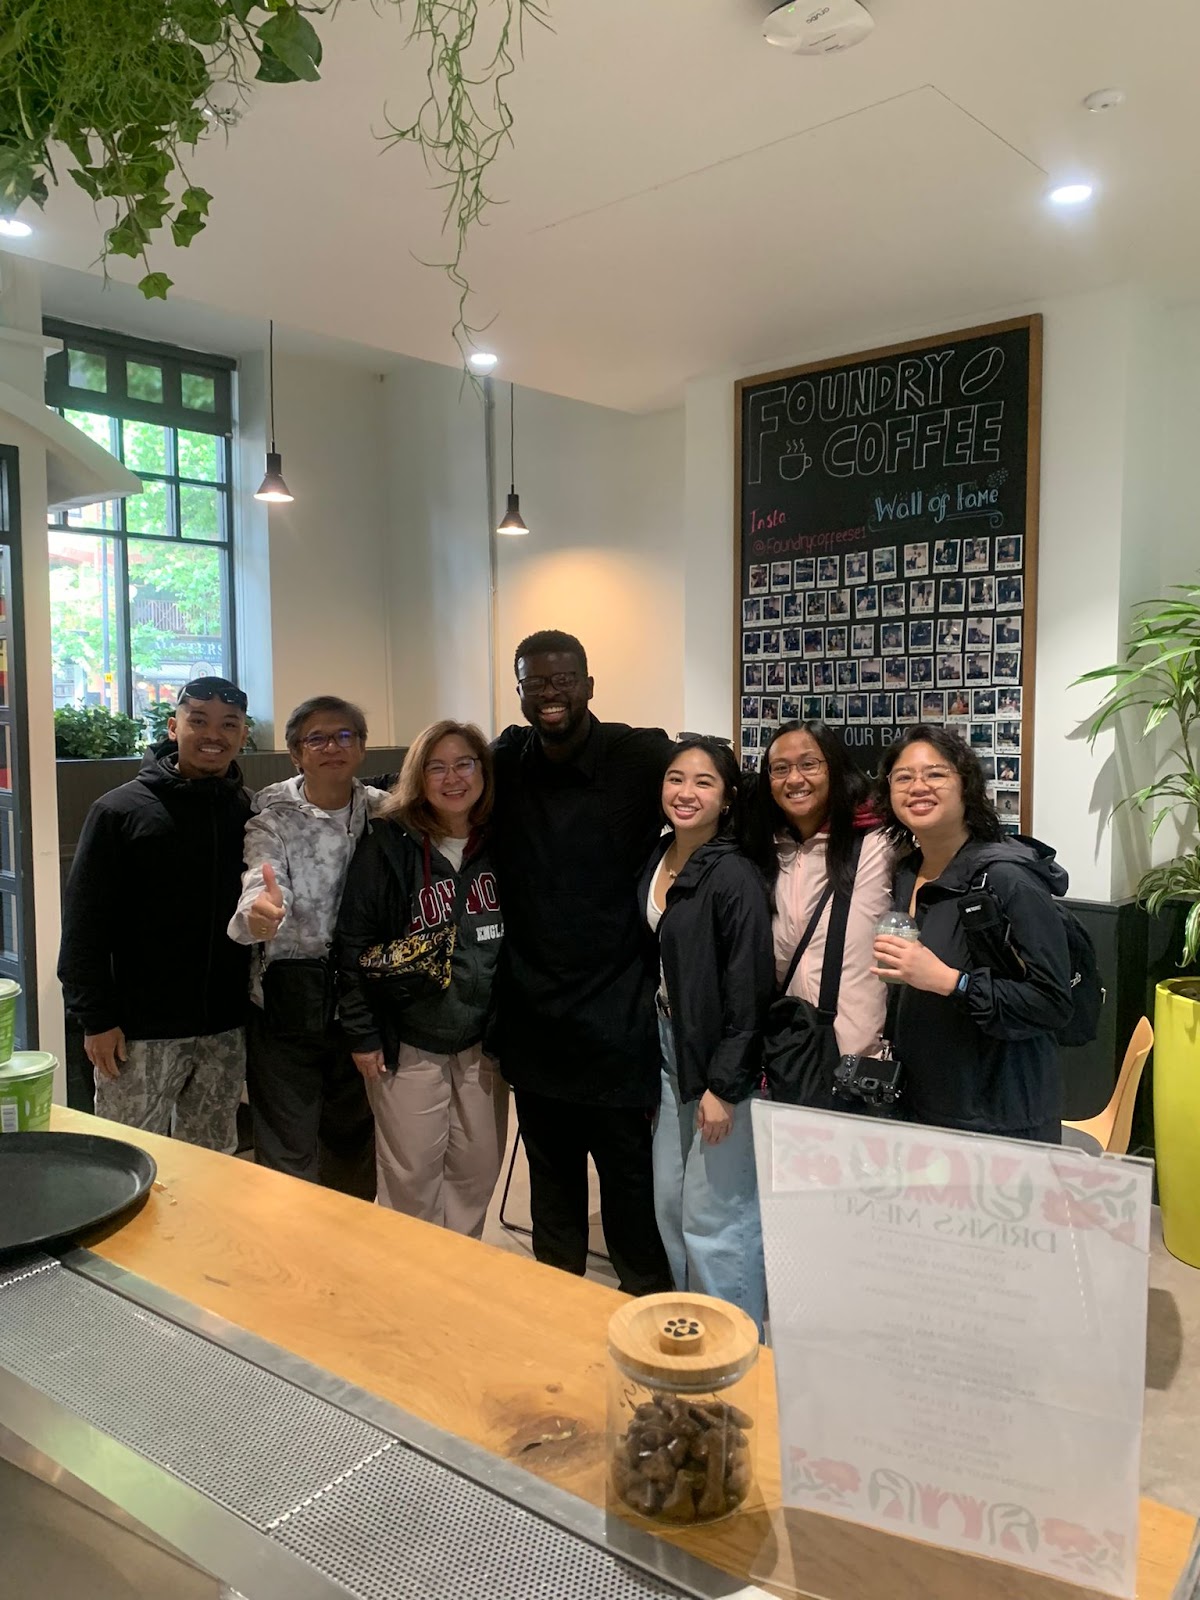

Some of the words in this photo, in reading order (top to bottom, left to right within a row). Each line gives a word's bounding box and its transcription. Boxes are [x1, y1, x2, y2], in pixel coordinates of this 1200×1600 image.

[748, 350, 955, 484] FOUNDRY
[822, 400, 1004, 477] COFFEE
[750, 508, 786, 535] Insta
[875, 490, 922, 522] Wall
[928, 493, 950, 523] of
[844, 726, 874, 746] OUR
